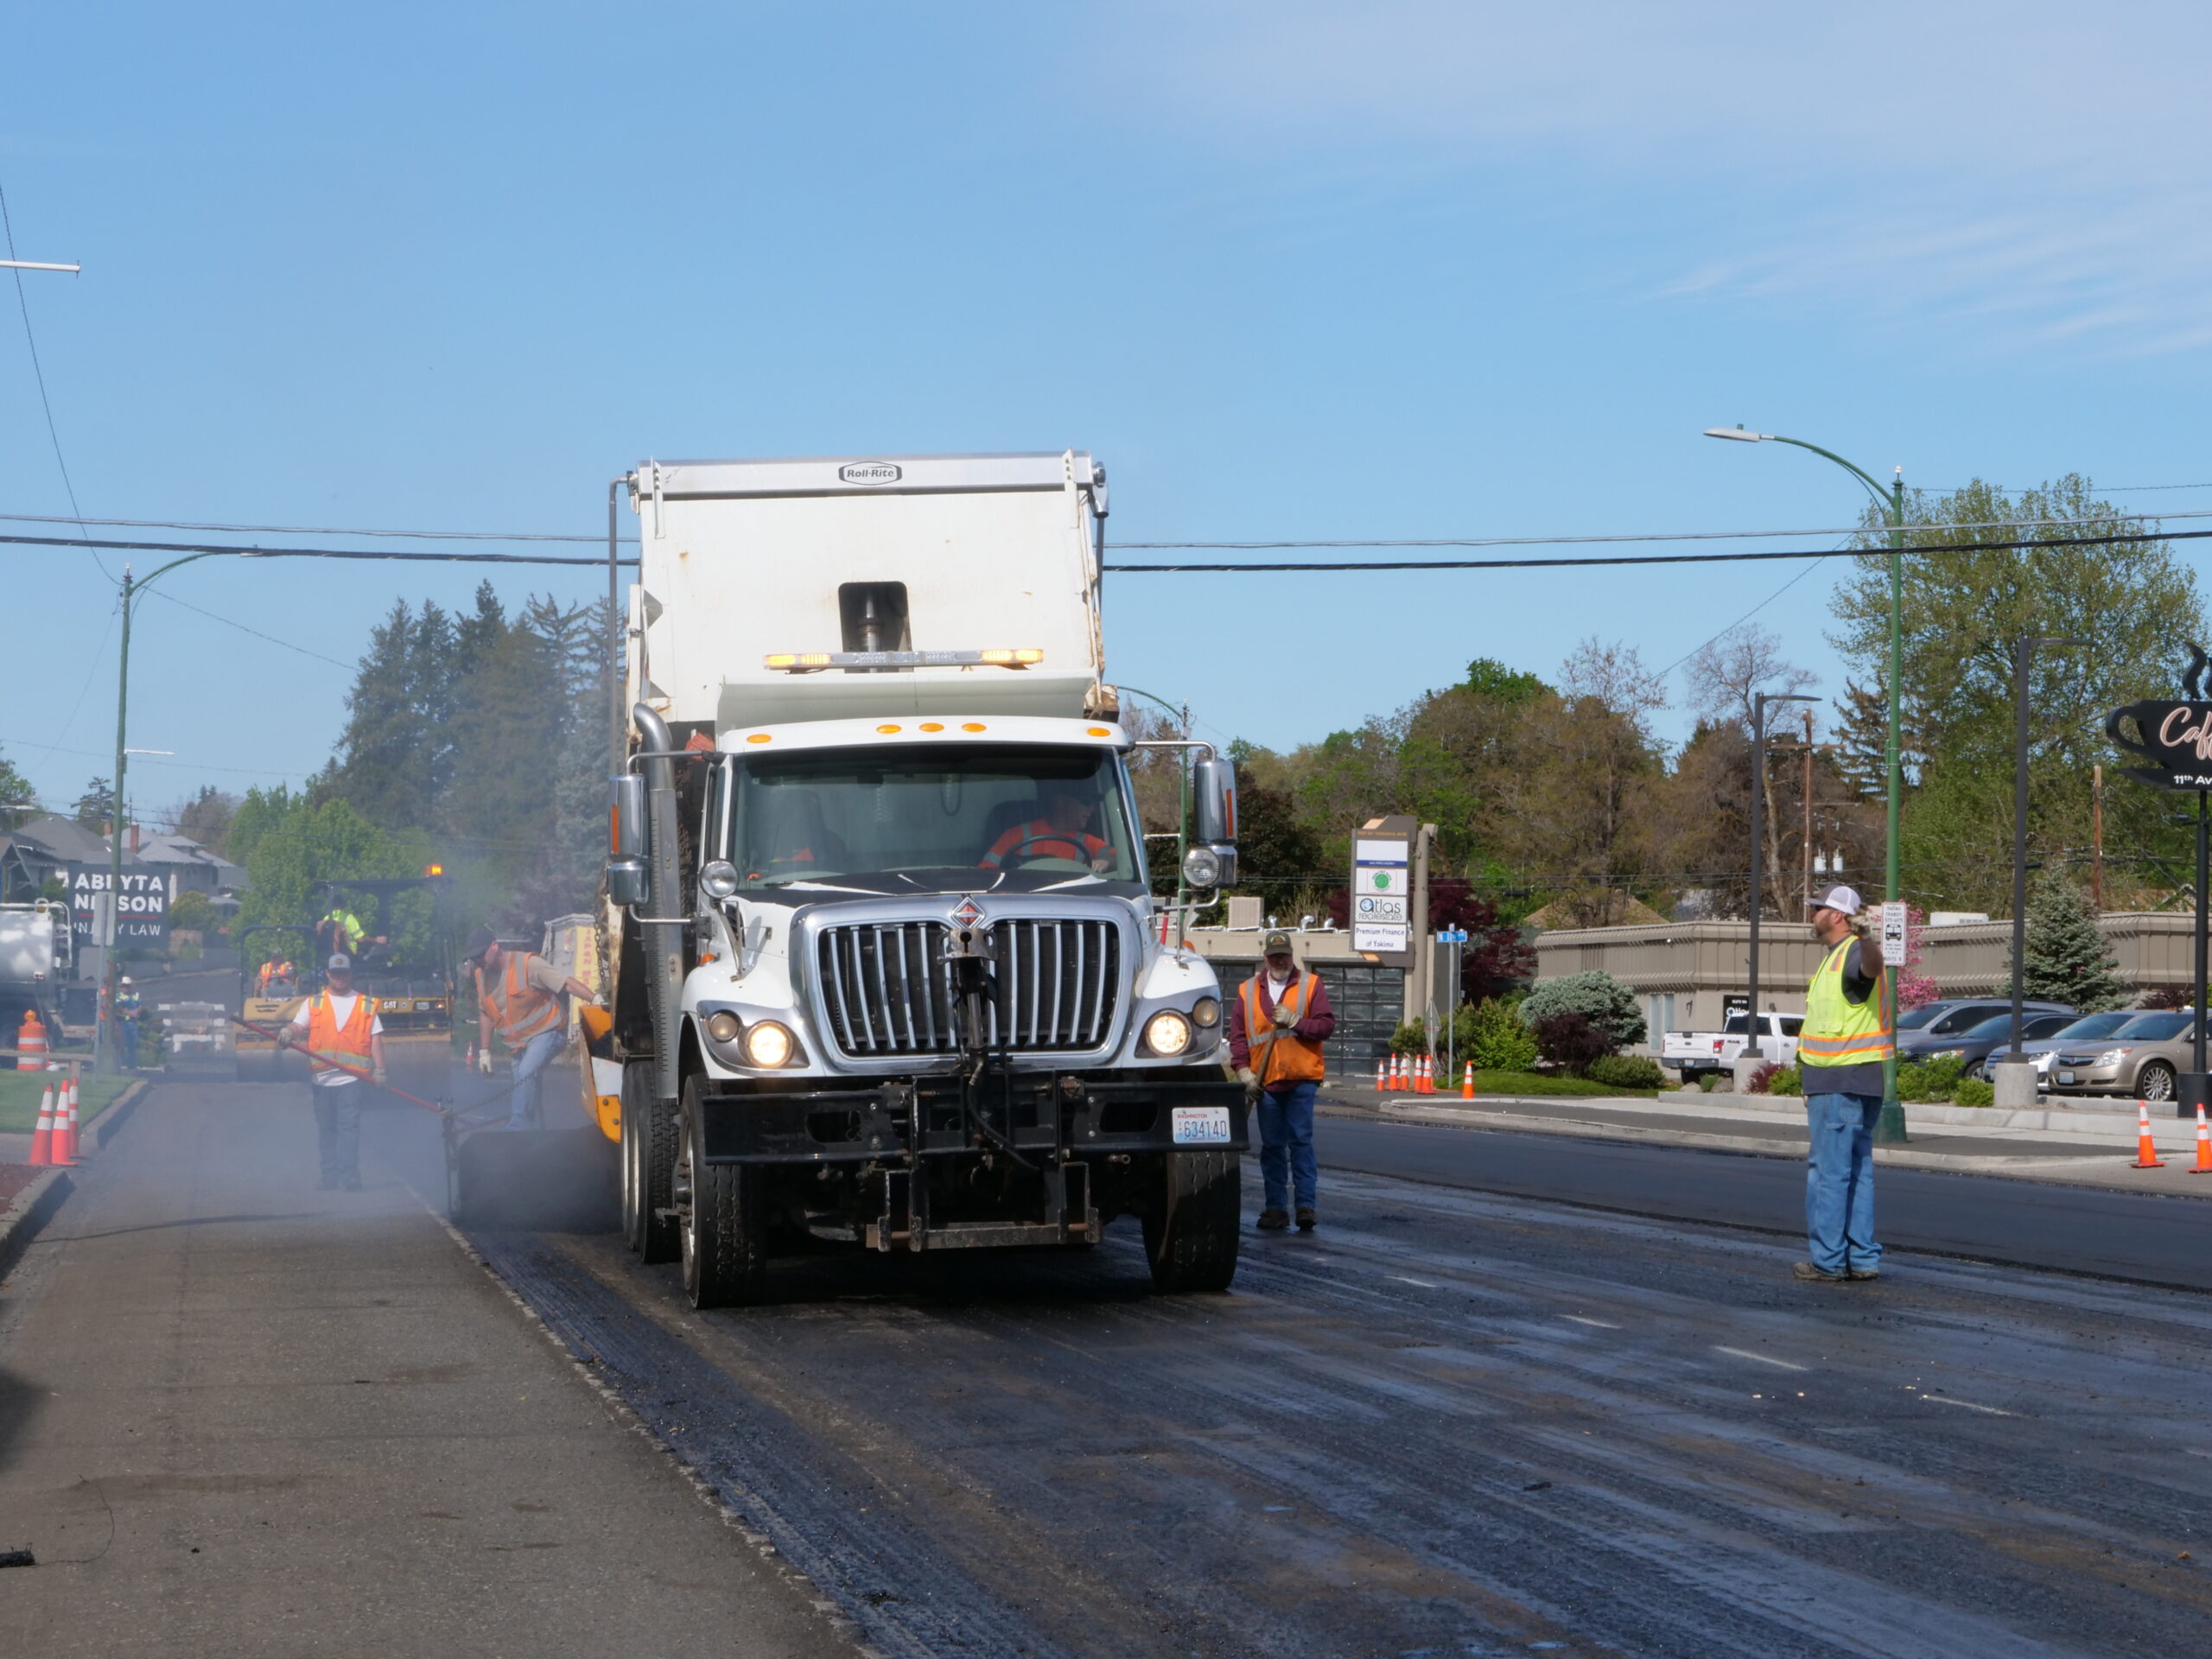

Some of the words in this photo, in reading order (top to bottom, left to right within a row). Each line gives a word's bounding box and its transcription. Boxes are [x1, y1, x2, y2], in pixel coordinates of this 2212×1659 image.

[74, 893, 162, 912] NSON
[1360, 898, 1401, 913] atlas
[130, 924, 161, 936] LAW
[384, 1001, 397, 1009] CAT
[1184, 1121, 1226, 1137] 63414D
